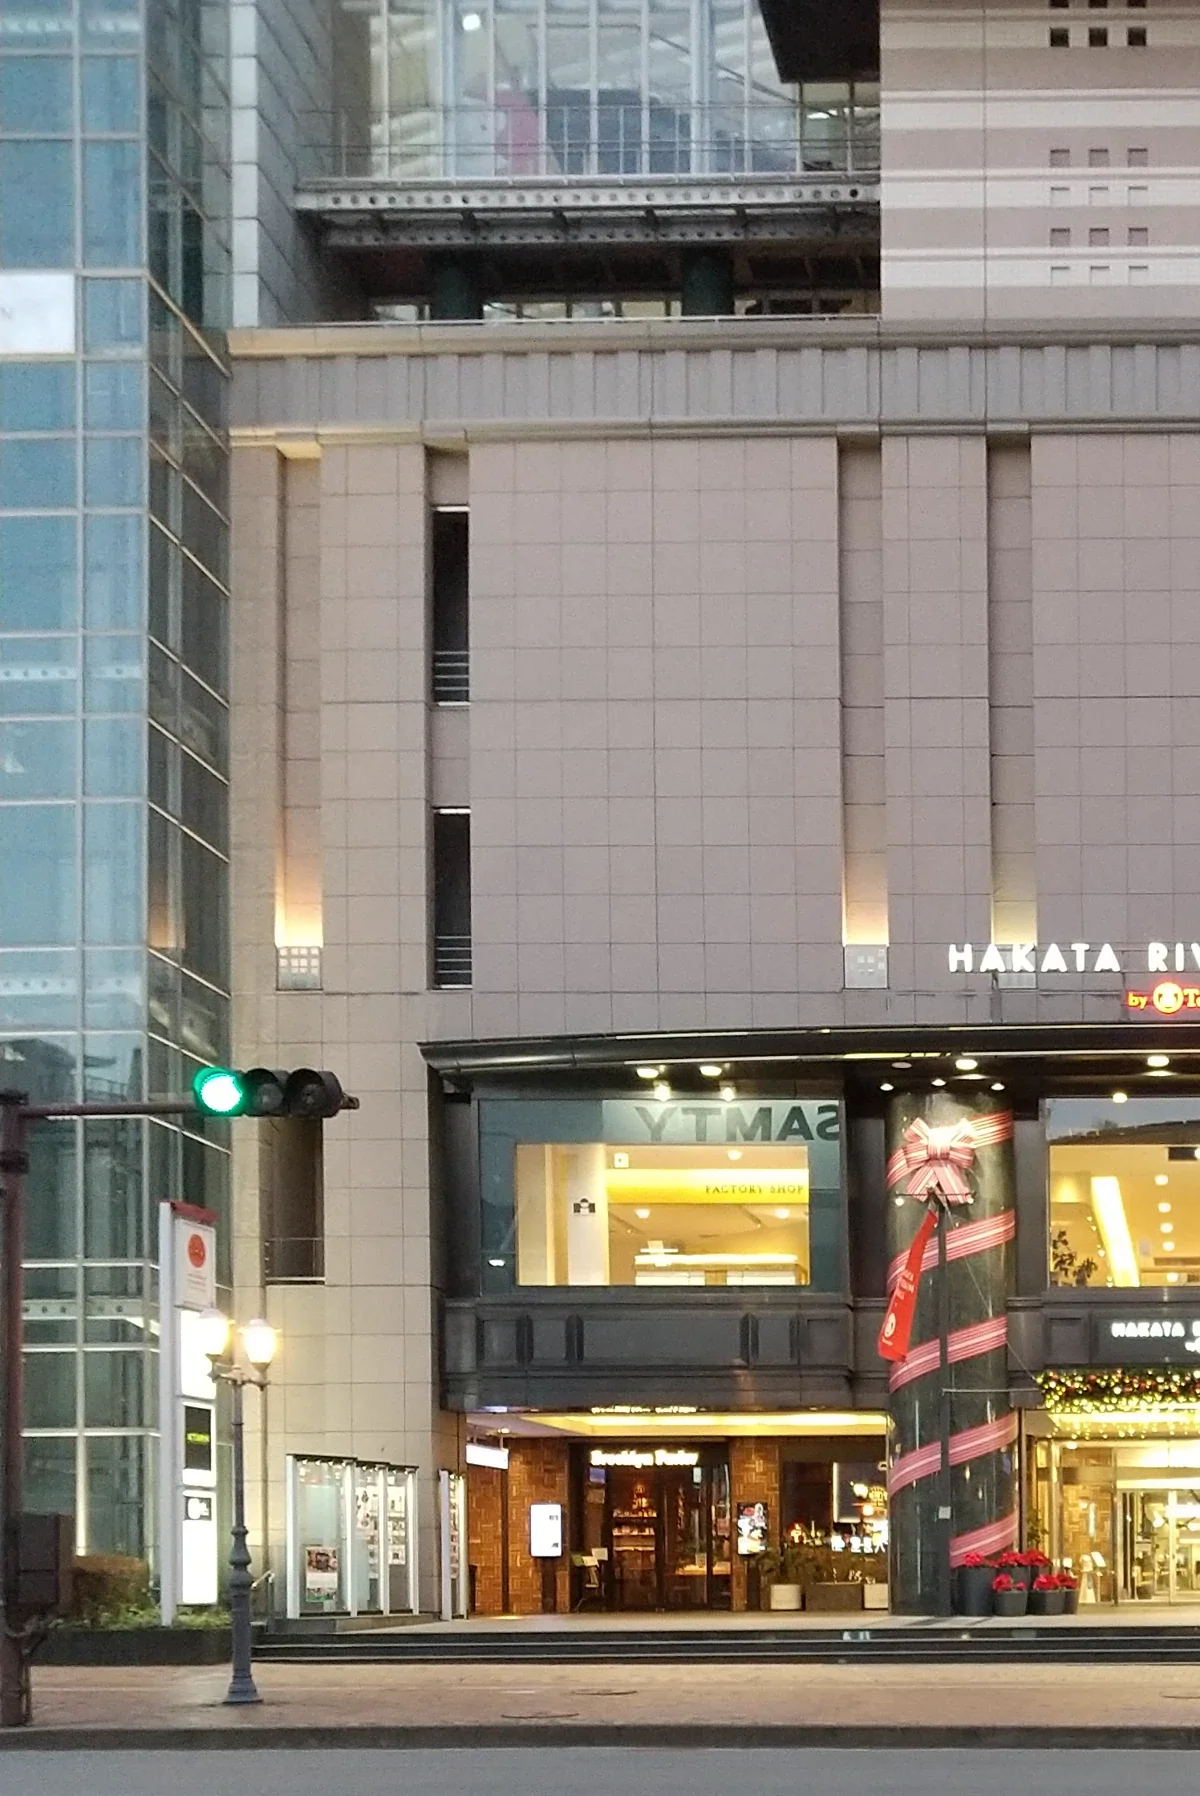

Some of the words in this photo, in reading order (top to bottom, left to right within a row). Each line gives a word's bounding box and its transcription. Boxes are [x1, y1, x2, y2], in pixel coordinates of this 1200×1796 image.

[948, 943, 1121, 973] HAKATA
[1128, 991, 1148, 1010] by
[705, 1184, 764, 1195] FACTORY
[770, 1184, 804, 1195] SHOP
[1111, 1322, 1185, 1337] HAKATA
